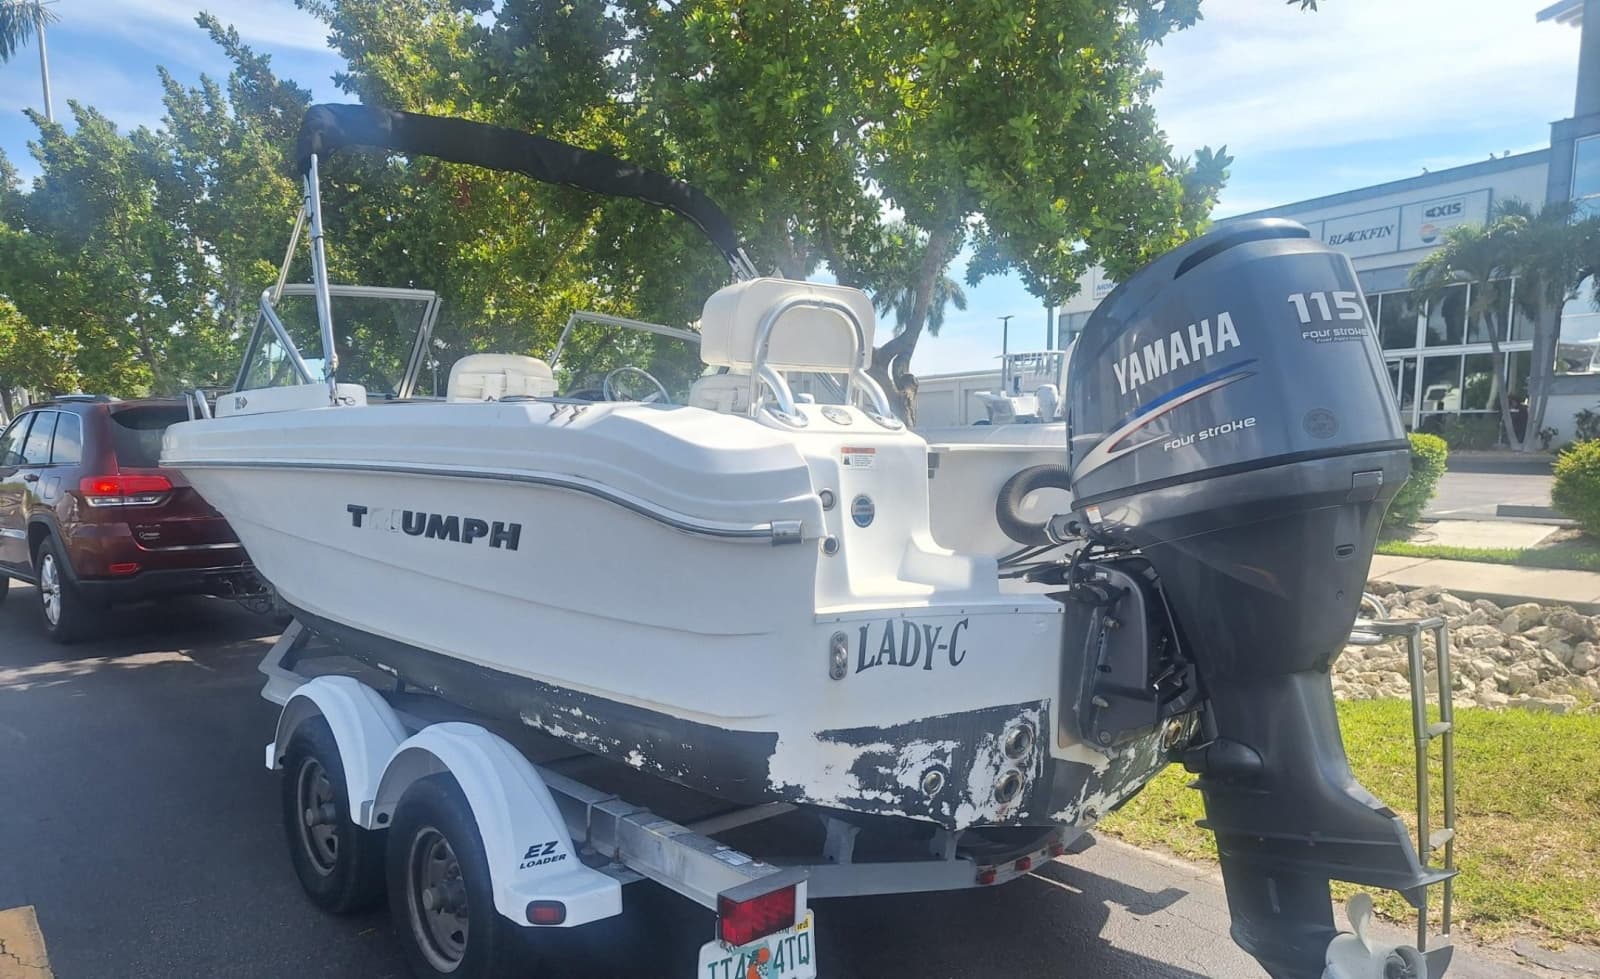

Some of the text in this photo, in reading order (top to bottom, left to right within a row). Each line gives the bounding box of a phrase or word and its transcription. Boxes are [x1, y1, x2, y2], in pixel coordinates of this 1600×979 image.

[1328, 224, 1395, 246] BLACKFIN
[1287, 291, 1363, 324] 115
[1113, 311, 1241, 396] YAMAHA
[347, 503, 522, 551] TUMPH
[855, 617, 969, 674] LADY-C
[519, 853, 567, 870] LOADER
[524, 840, 559, 860] EZ
